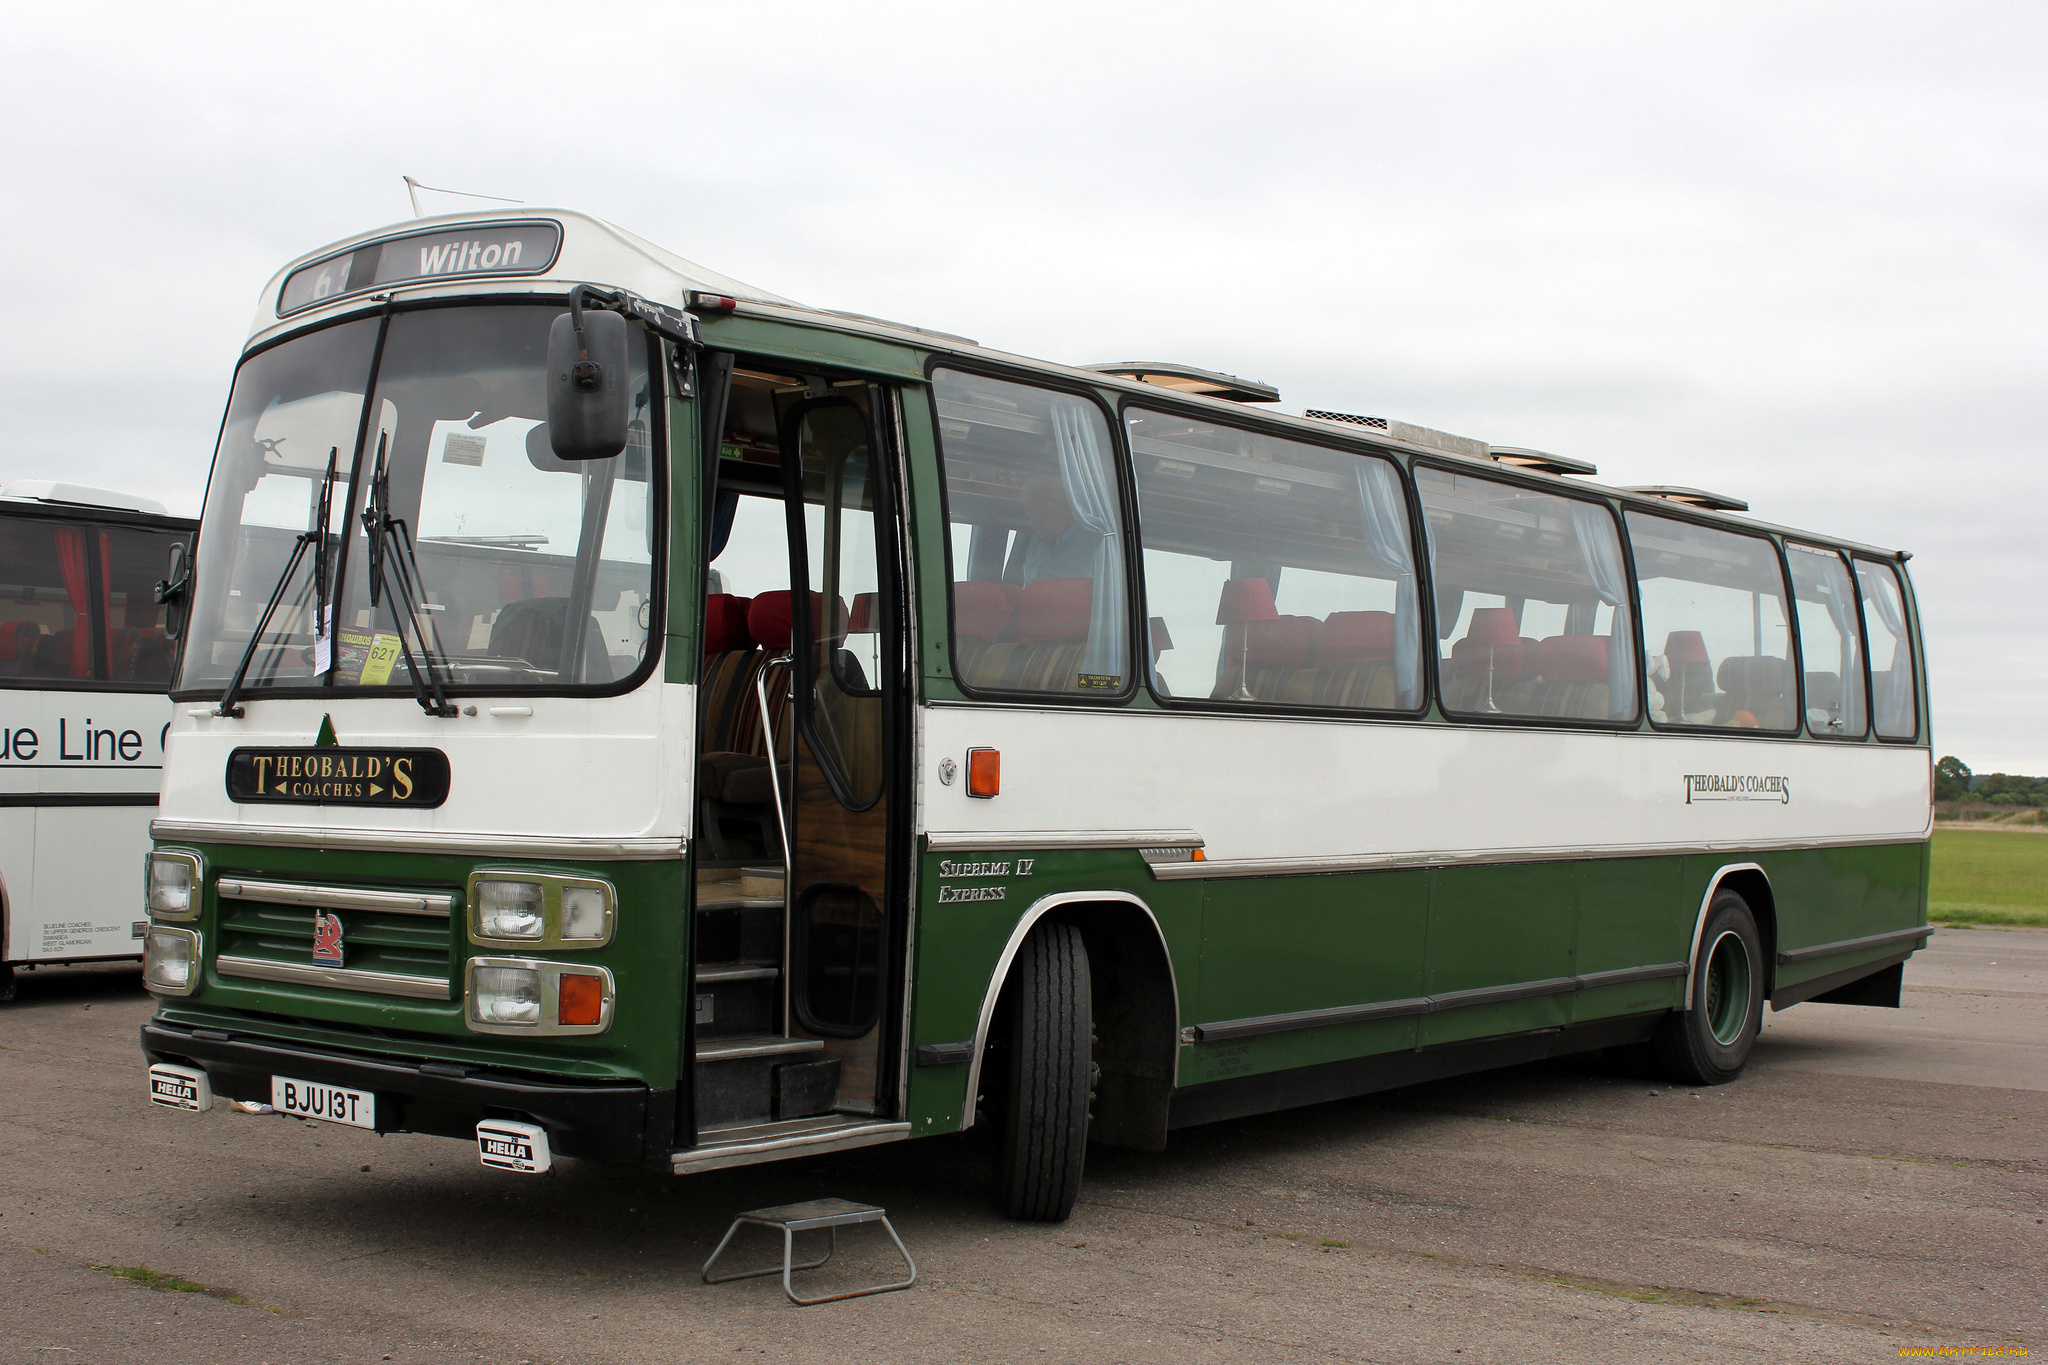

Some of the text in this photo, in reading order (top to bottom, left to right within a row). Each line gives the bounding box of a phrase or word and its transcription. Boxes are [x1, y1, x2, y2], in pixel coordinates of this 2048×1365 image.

[420, 240, 523, 276] Wilton
[371, 646, 395, 661] 621
[59, 717, 142, 761] Line
[252, 756, 414, 800] THEOBALD'S
[292, 782, 362, 797] COACHES
[1683, 774, 1790, 805] THEOBALD'S COACHES
[939, 858, 1035, 878] SUPREME IV
[938, 884, 1006, 904] EXPRESS
[157, 1081, 192, 1099] HELLA
[487, 1140, 526, 1158] HELLA
